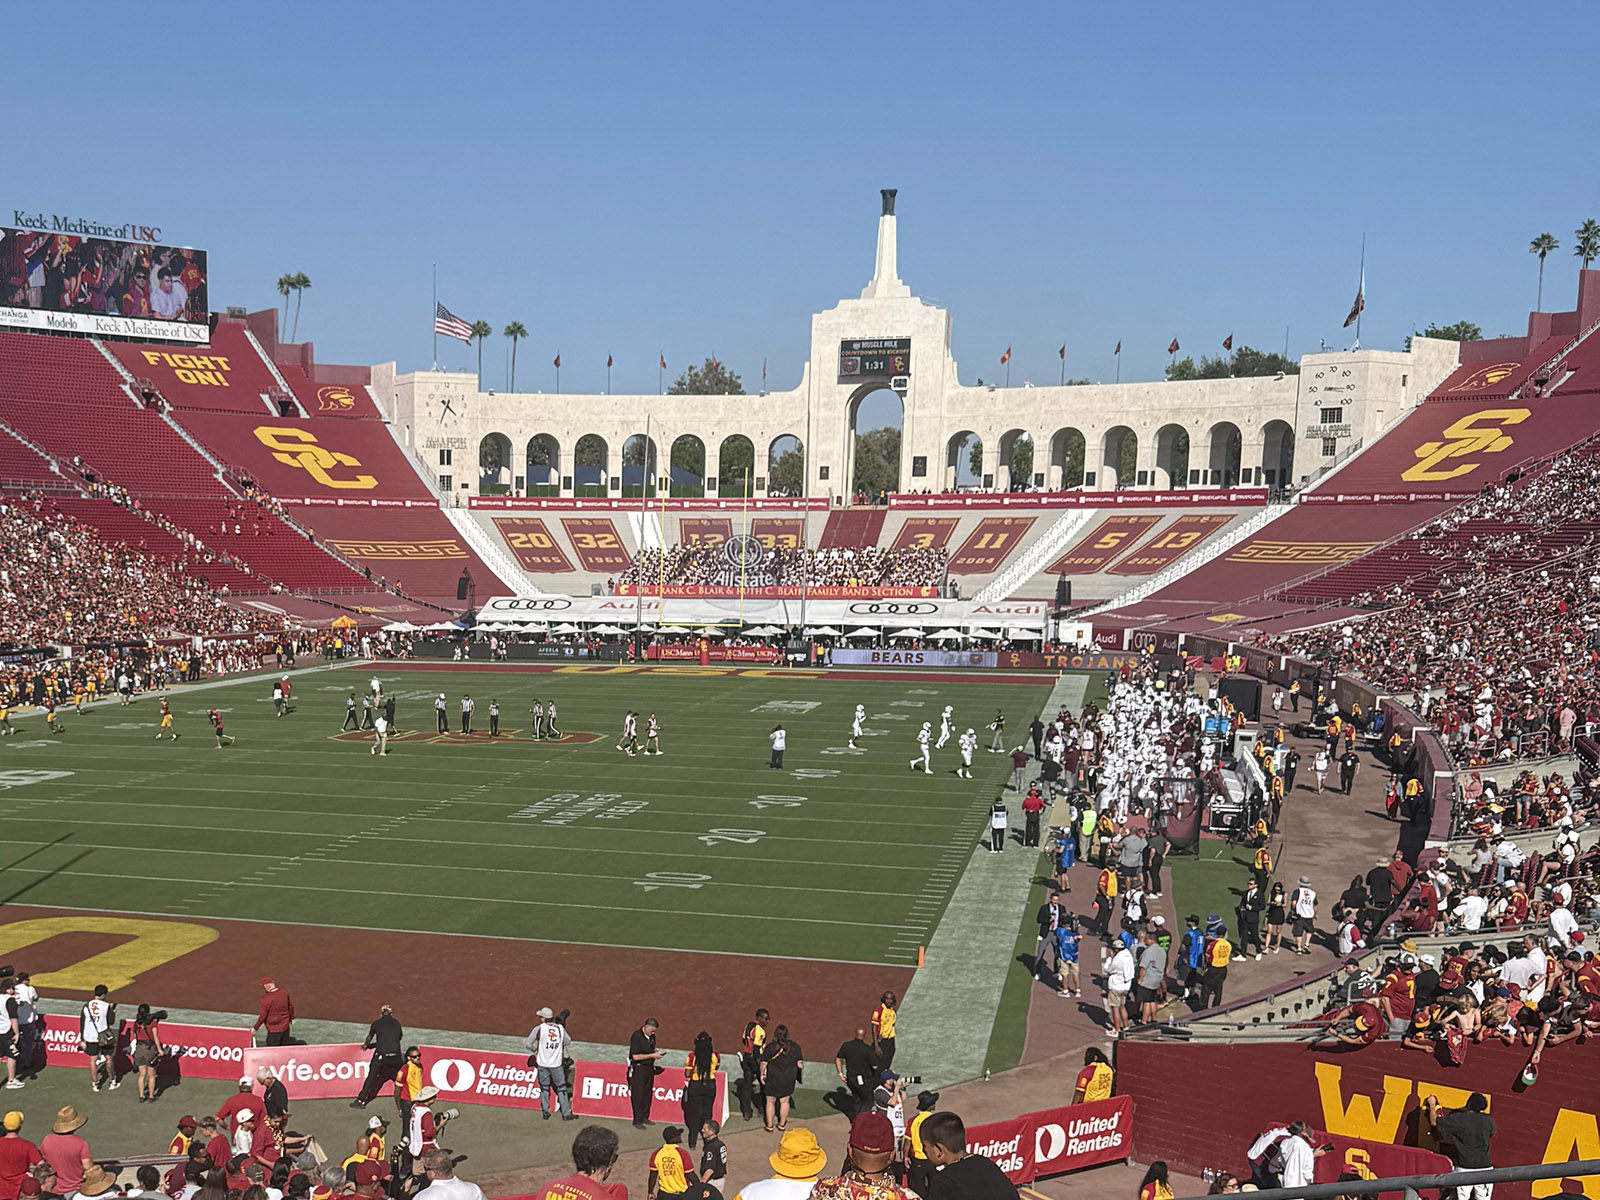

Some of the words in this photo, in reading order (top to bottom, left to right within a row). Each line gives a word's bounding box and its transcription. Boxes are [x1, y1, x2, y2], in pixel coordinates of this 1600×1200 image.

[14, 210, 48, 229] Keck
[52, 215, 112, 238] Medicine
[114, 224, 130, 239] of
[132, 225, 162, 243] USC
[47, 315, 78, 329] Modelo
[96, 318, 120, 333] Keck
[124, 321, 170, 337] Medicine
[171, 325, 182, 338] of
[184, 326, 207, 340] USC
[140, 350, 231, 372] FIGHT
[865, 361, 884, 370] 1:31
[173, 368, 230, 388] ON!
[1401, 408, 1532, 482] SC
[253, 426, 379, 490] SC
[506, 532, 552, 548] 20
[572, 533, 620, 548] 32
[756, 534, 797, 549] 33
[908, 533, 936, 549] 3
[974, 533, 1009, 549] 11
[1094, 532, 1128, 549] 5
[1150, 532, 1201, 549] 13
[524, 556, 562, 564] 1965
[1064, 557, 1104, 565] 2005
[1127, 557, 1167, 565] 2022
[713, 570, 775, 588] Allstate
[654, 586, 684, 595] FRANK
[686, 586, 696, 595] C.
[698, 586, 724, 595] BLAIR
[726, 587, 734, 595] &
[736, 586, 763, 596] RUTH
[765, 588, 775, 596] C.
[778, 588, 803, 596] BLAIR
[806, 588, 839, 596] FAMILY
[842, 588, 869, 596] BAND
[872, 588, 914, 596] SECTION
[598, 602, 660, 610] Audi
[971, 604, 1040, 614] Audi
[1094, 632, 1117, 644] Audi
[871, 652, 924, 664] BEARS
[1010, 653, 1020, 668] SC
[1044, 655, 1138, 669] TROJANS
[507, 794, 580, 818] UNITED
[541, 794, 622, 825] AIRLINES
[594, 800, 650, 820] FIELD
[698, 828, 767, 844] 20
[633, 872, 712, 889] 10
[209, 1045, 243, 1062] QQQ
[479, 1062, 538, 1083] United
[476, 1078, 541, 1100] Rentals
[1068, 1111, 1120, 1138] United
[1066, 1130, 1122, 1156] Rentals
[995, 1154, 1024, 1174] tals
